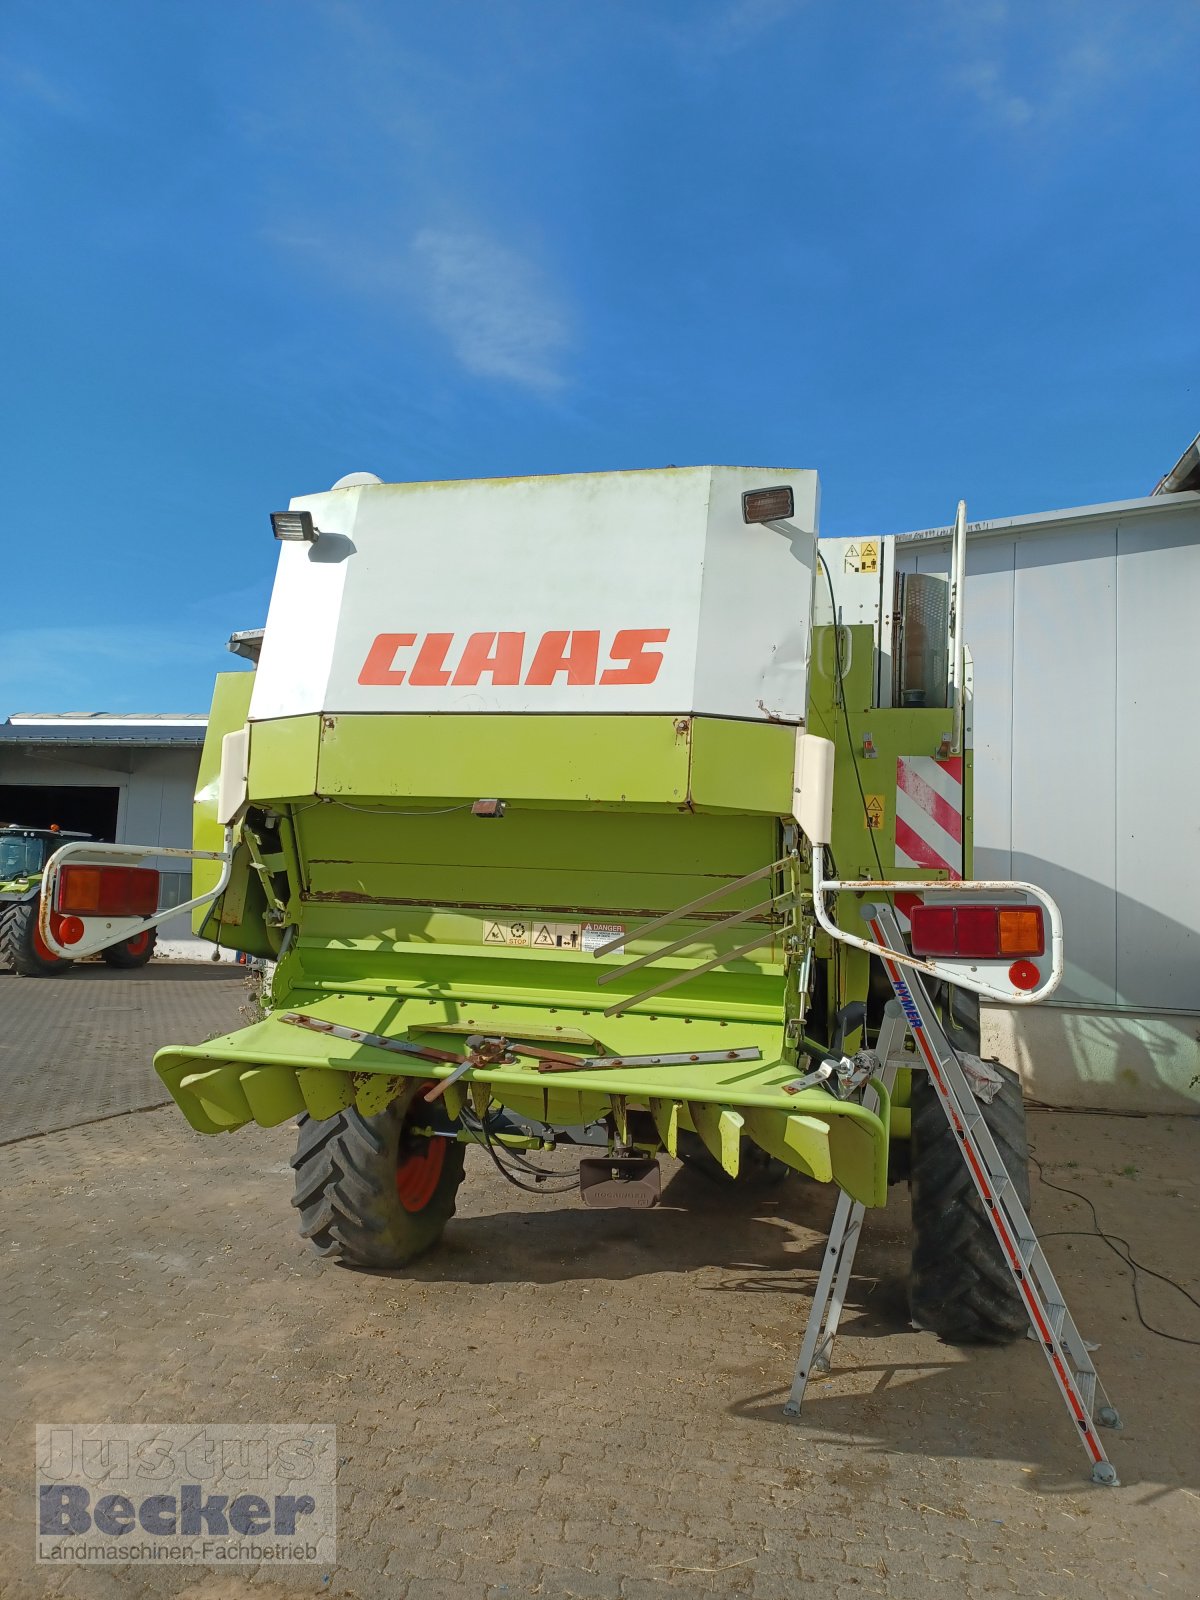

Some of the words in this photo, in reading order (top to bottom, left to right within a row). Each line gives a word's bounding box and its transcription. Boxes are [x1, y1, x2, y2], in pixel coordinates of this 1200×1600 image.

[358, 629, 670, 686] CLAAS
[593, 924, 622, 932] DANGER
[892, 981, 923, 1028] HYMER
